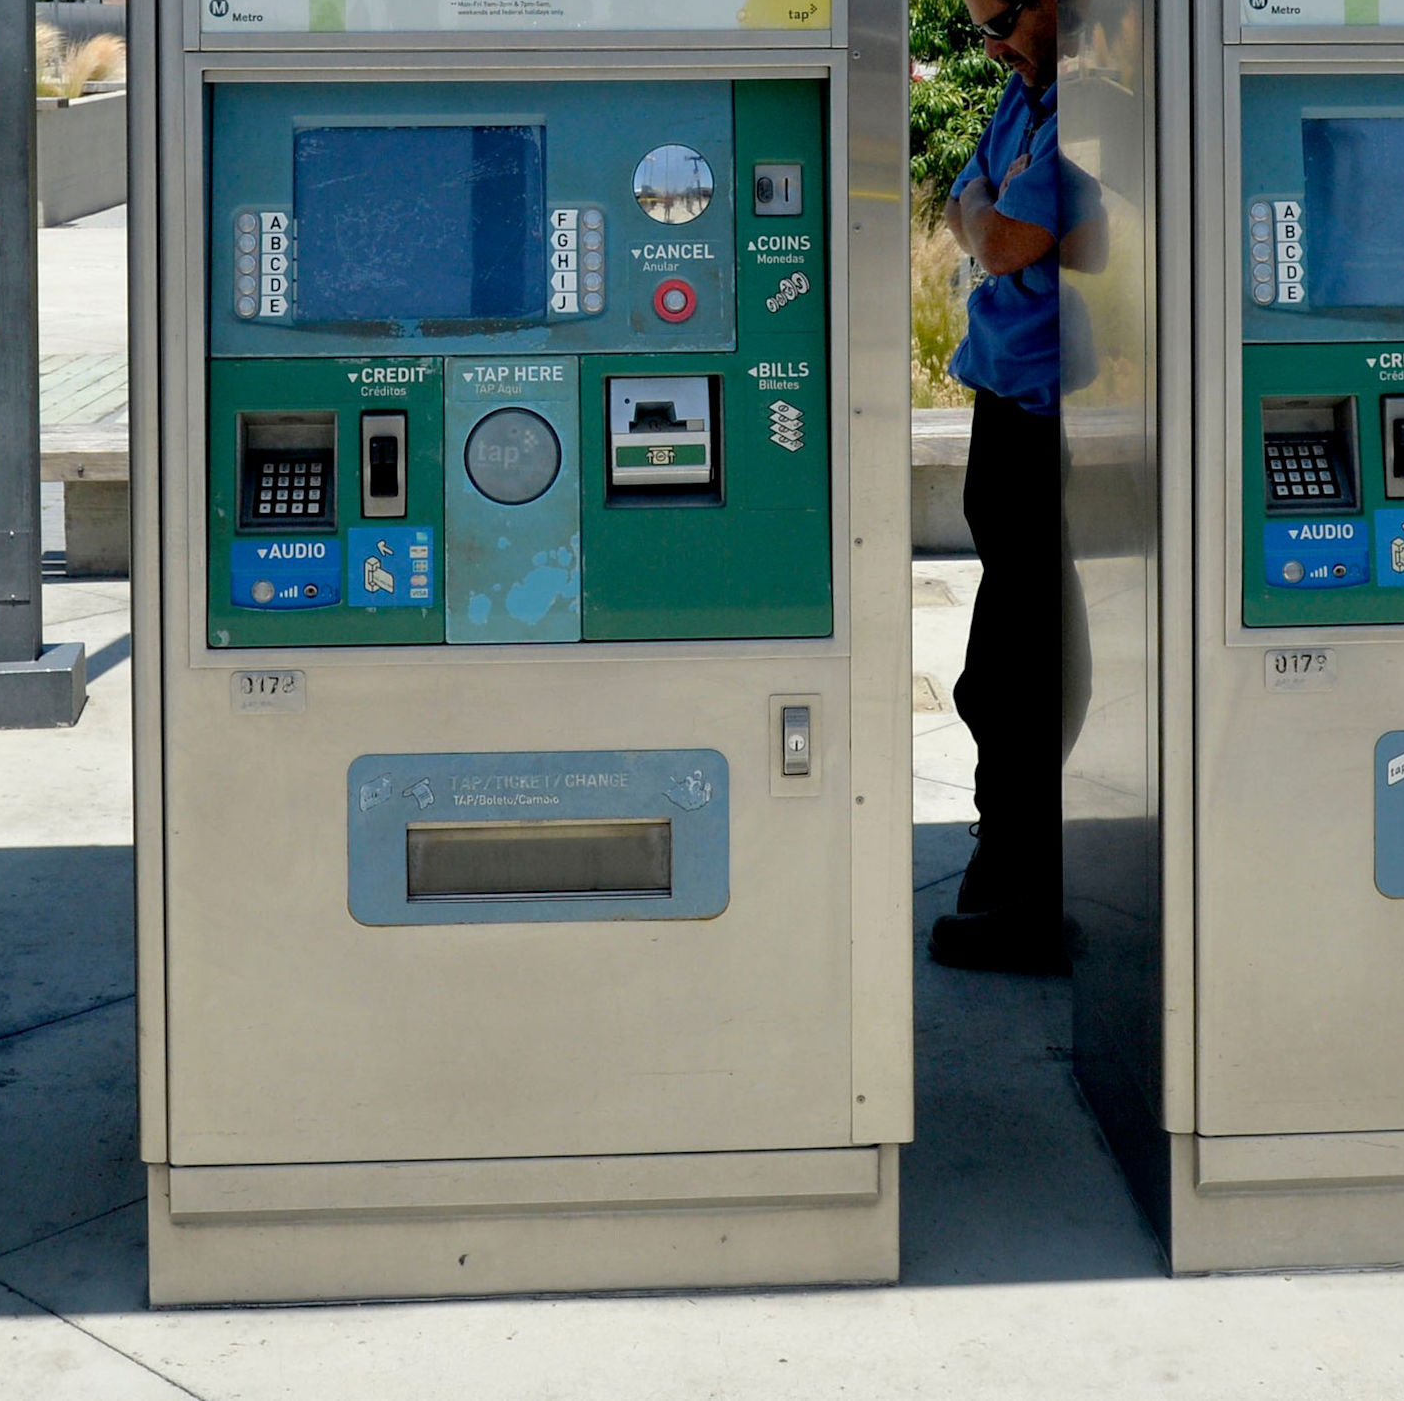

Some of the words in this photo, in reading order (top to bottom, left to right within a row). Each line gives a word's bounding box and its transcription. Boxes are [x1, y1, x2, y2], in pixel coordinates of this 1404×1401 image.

[232, 13, 263, 22] Metro
[788, 9, 810, 22] tap
[1271, 6, 1301, 15] Metro
[269, 216, 281, 230] A
[557, 213, 567, 227] F
[271, 237, 281, 251] B
[557, 234, 568, 247] G
[757, 235, 811, 250] COINS
[643, 243, 715, 259] CANCEL
[270, 257, 281, 271] C
[557, 254, 569, 268] H
[757, 253, 805, 264] Monedas
[642, 261, 680, 272] Anular
[270, 278, 281, 292] D
[270, 299, 280, 313] E
[557, 295, 566, 309] J
[361, 367, 426, 383] CREDIT
[474, 367, 511, 382] TAP
[514, 366, 564, 382] HERE
[759, 362, 810, 377] BILLS
[360, 386, 407, 397] Créditos
[758, 380, 800, 390] Billetes
[476, 442, 520, 467] tap
[1300, 524, 1354, 539] AUDIO
[268, 543, 326, 559] AUDIO
